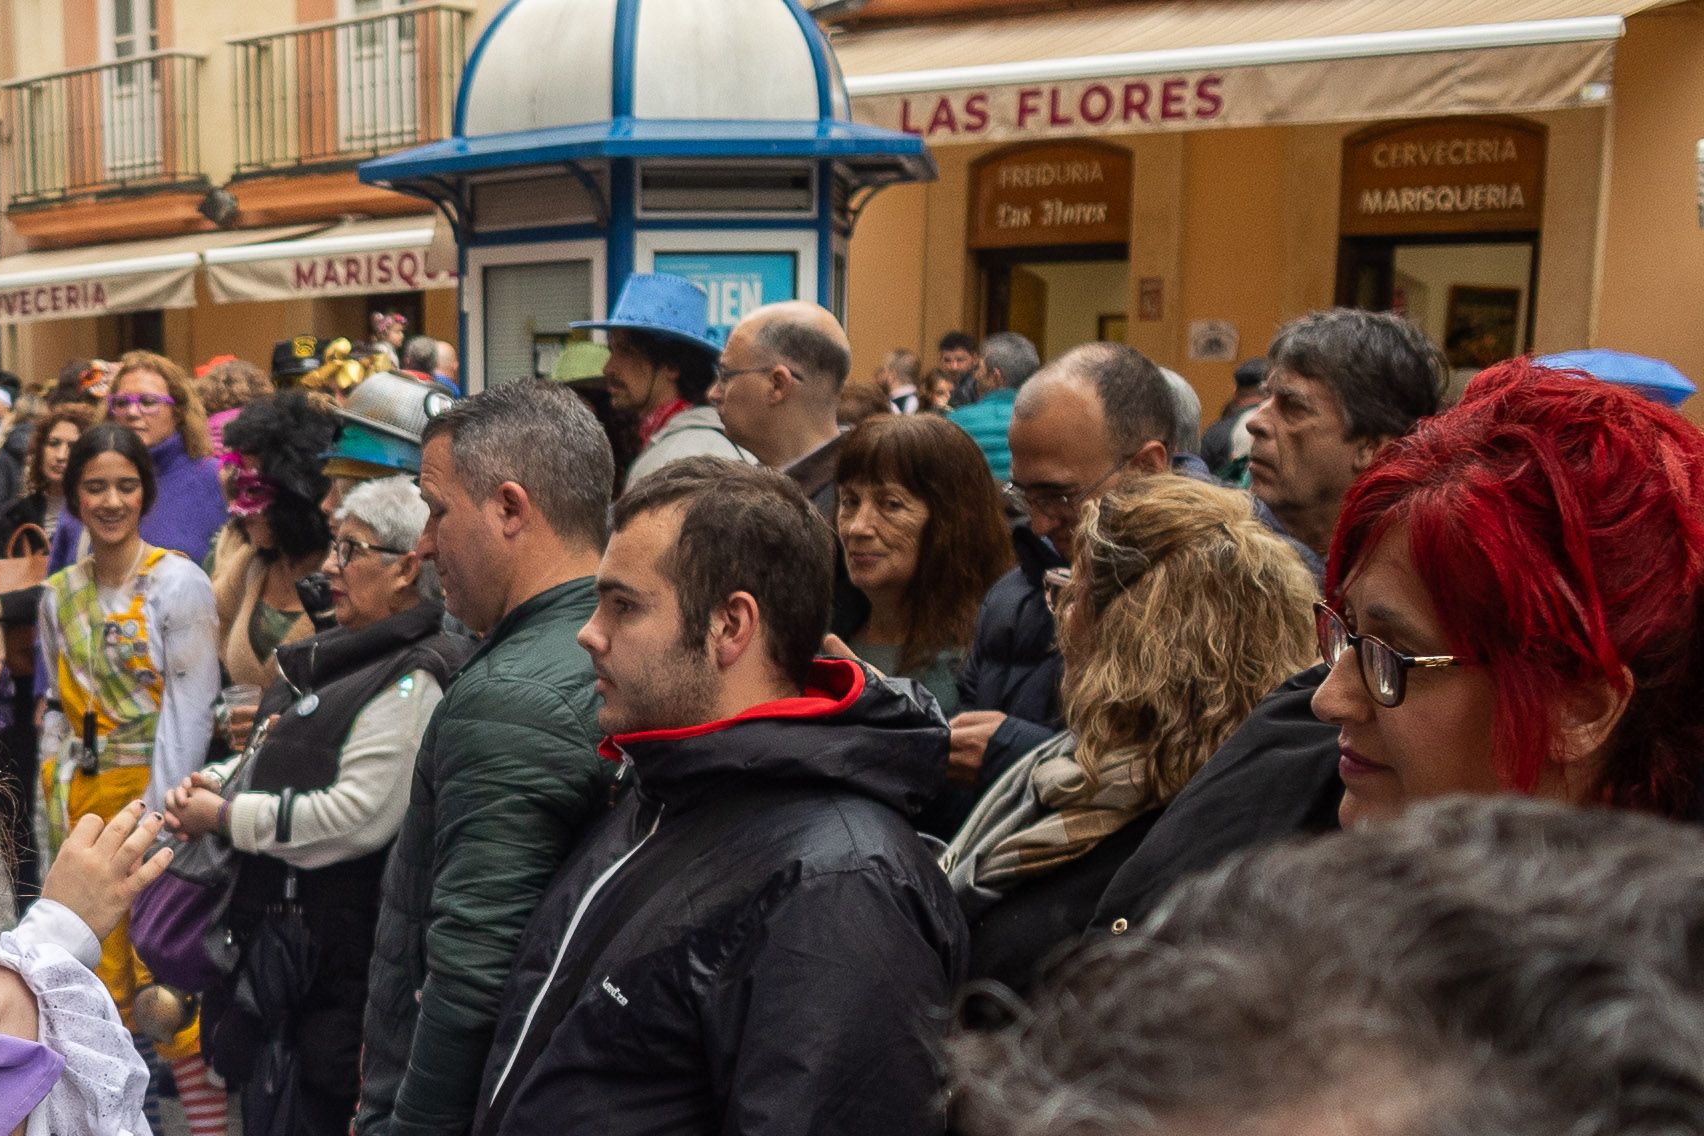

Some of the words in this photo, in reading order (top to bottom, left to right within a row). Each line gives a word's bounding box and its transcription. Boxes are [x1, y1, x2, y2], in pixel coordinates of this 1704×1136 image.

[900, 92, 991, 136] LAS
[1016, 75, 1223, 129] FLORES
[1360, 181, 1526, 215] MARISQUERIA
[692, 280, 763, 326] IEN
